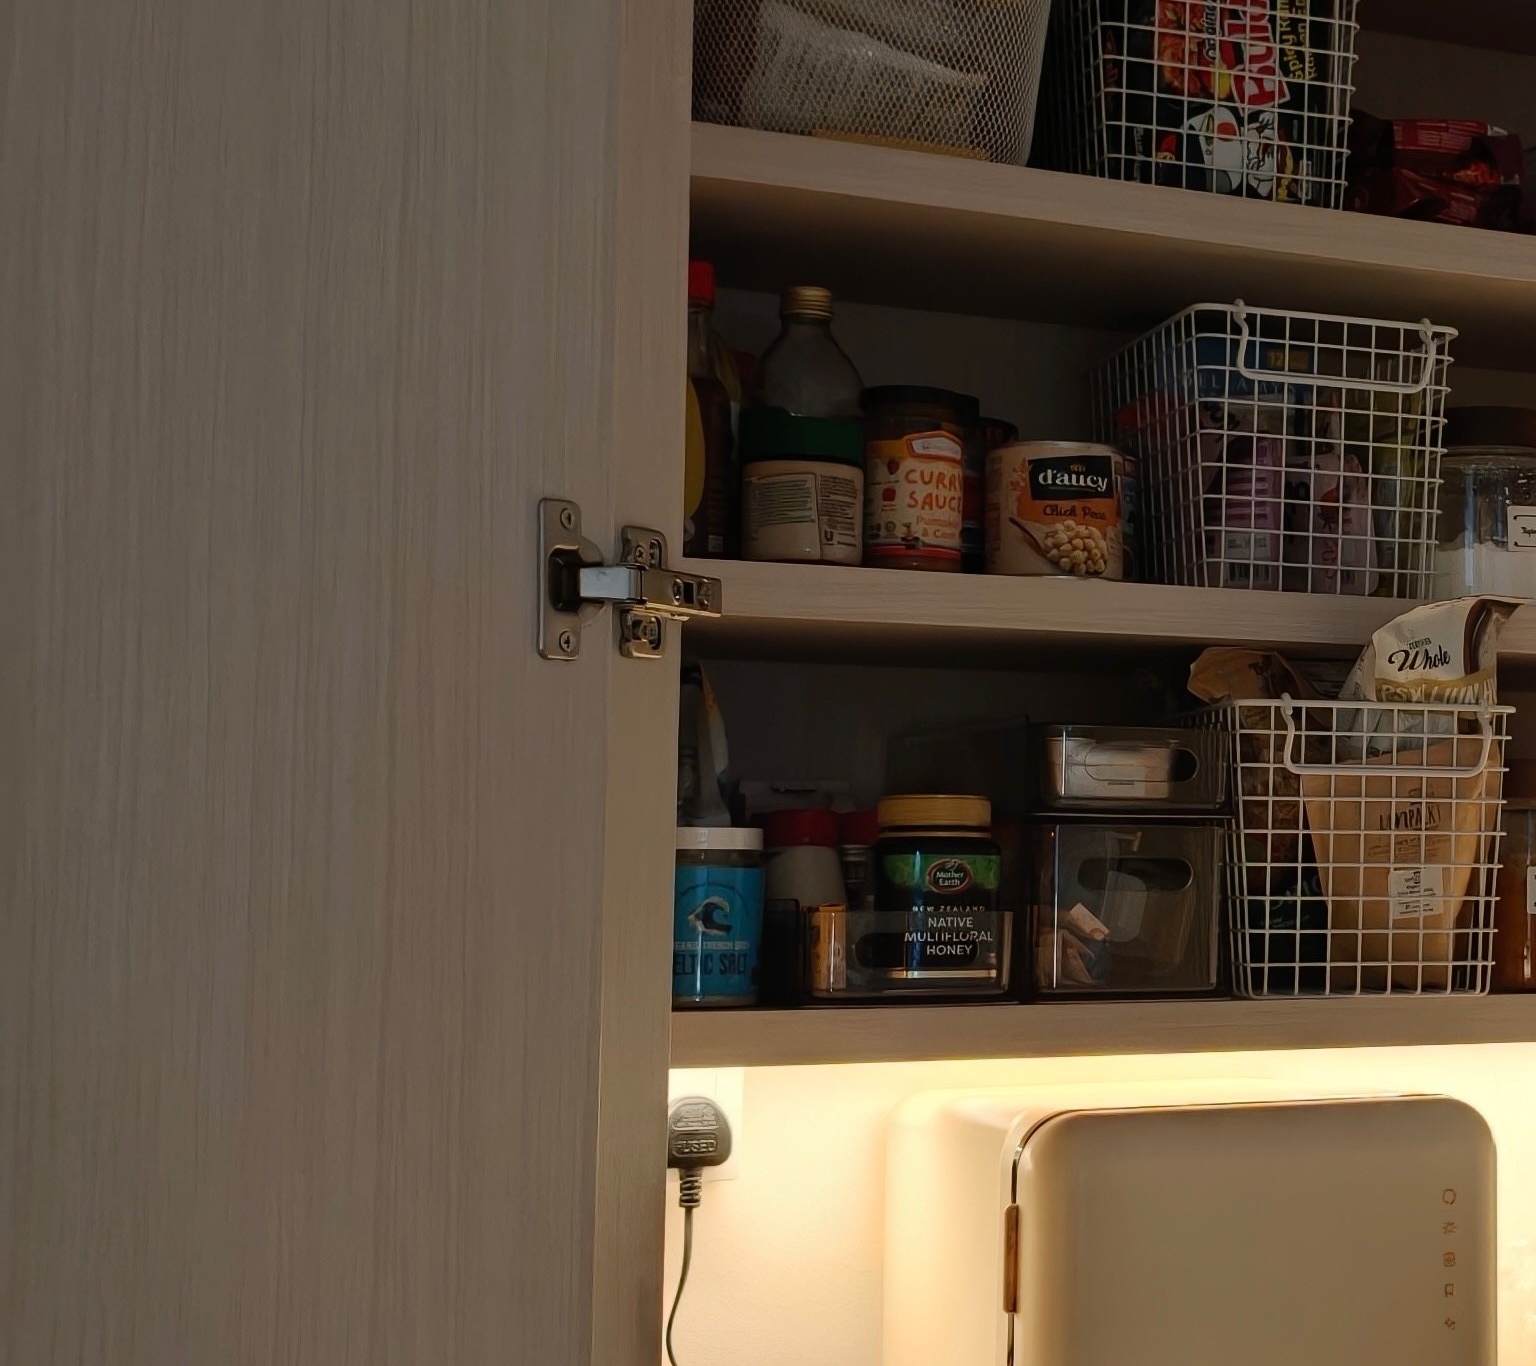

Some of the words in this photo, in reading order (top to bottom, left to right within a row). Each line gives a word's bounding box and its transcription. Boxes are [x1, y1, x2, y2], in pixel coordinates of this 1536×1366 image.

[1387, 645, 1451, 673] Whole
[936, 870, 964, 879] Mother
[938, 878, 961, 886] Earth
[939, 905, 986, 913] ZEALAND
[927, 916, 974, 928] NATIVE
[904, 931, 994, 943] MULTIFLORAL
[926, 944, 973, 956] HONEY
[674, 953, 714, 976] ELTC
